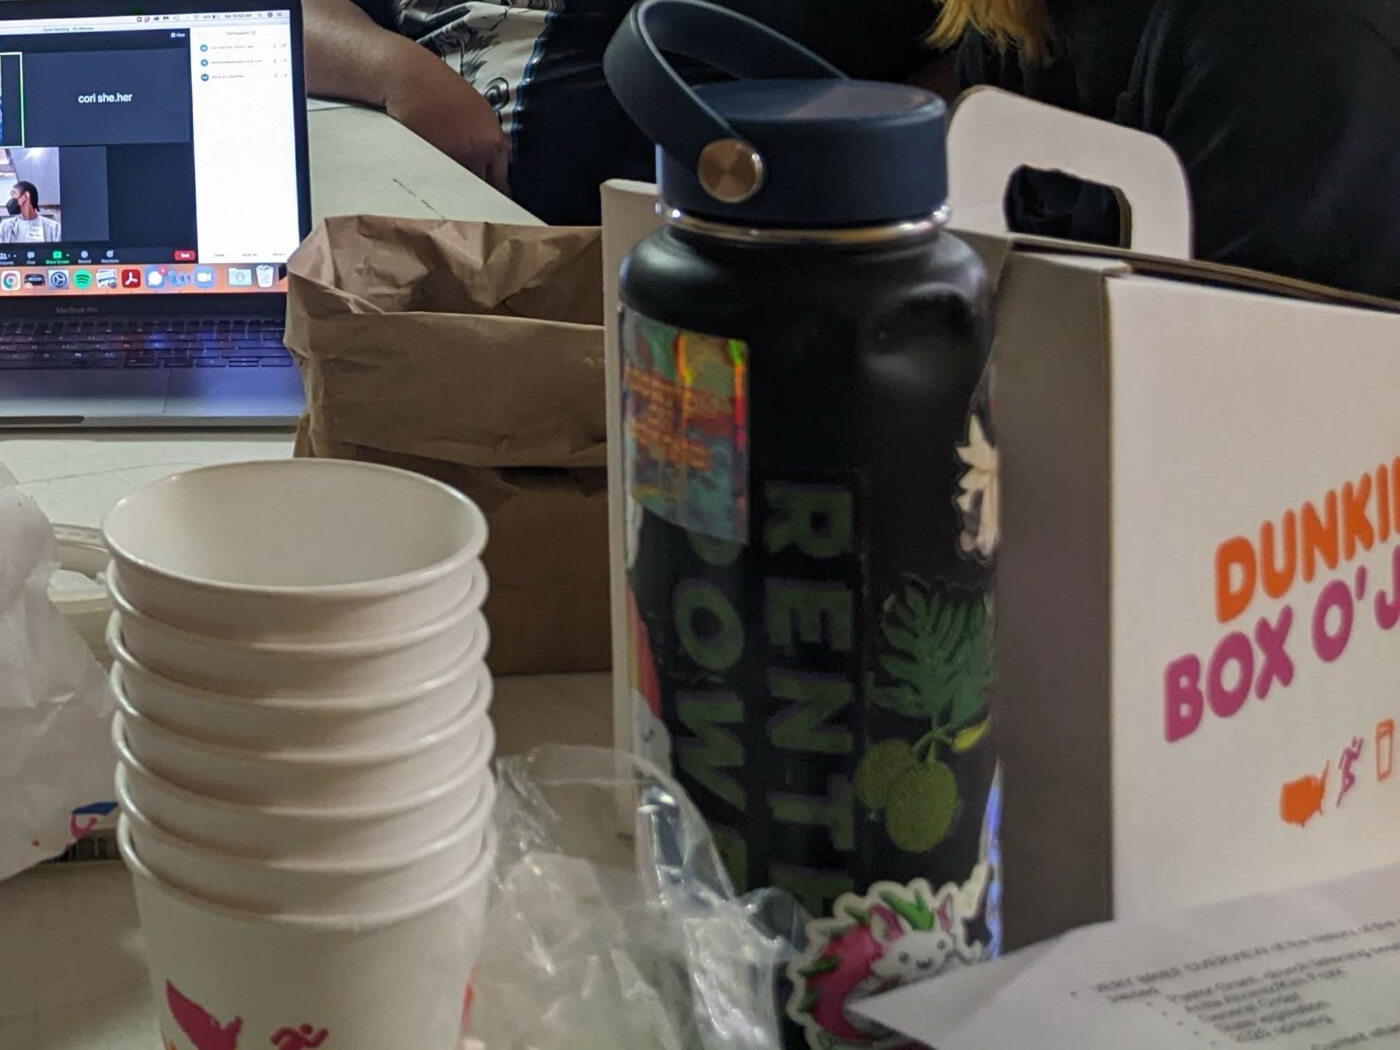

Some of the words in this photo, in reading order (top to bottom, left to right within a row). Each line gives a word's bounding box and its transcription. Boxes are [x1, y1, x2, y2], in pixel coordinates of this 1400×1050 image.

[77, 93, 96, 105] cori
[97, 91, 133, 104] she.her
[1163, 603, 1294, 744] BOX
